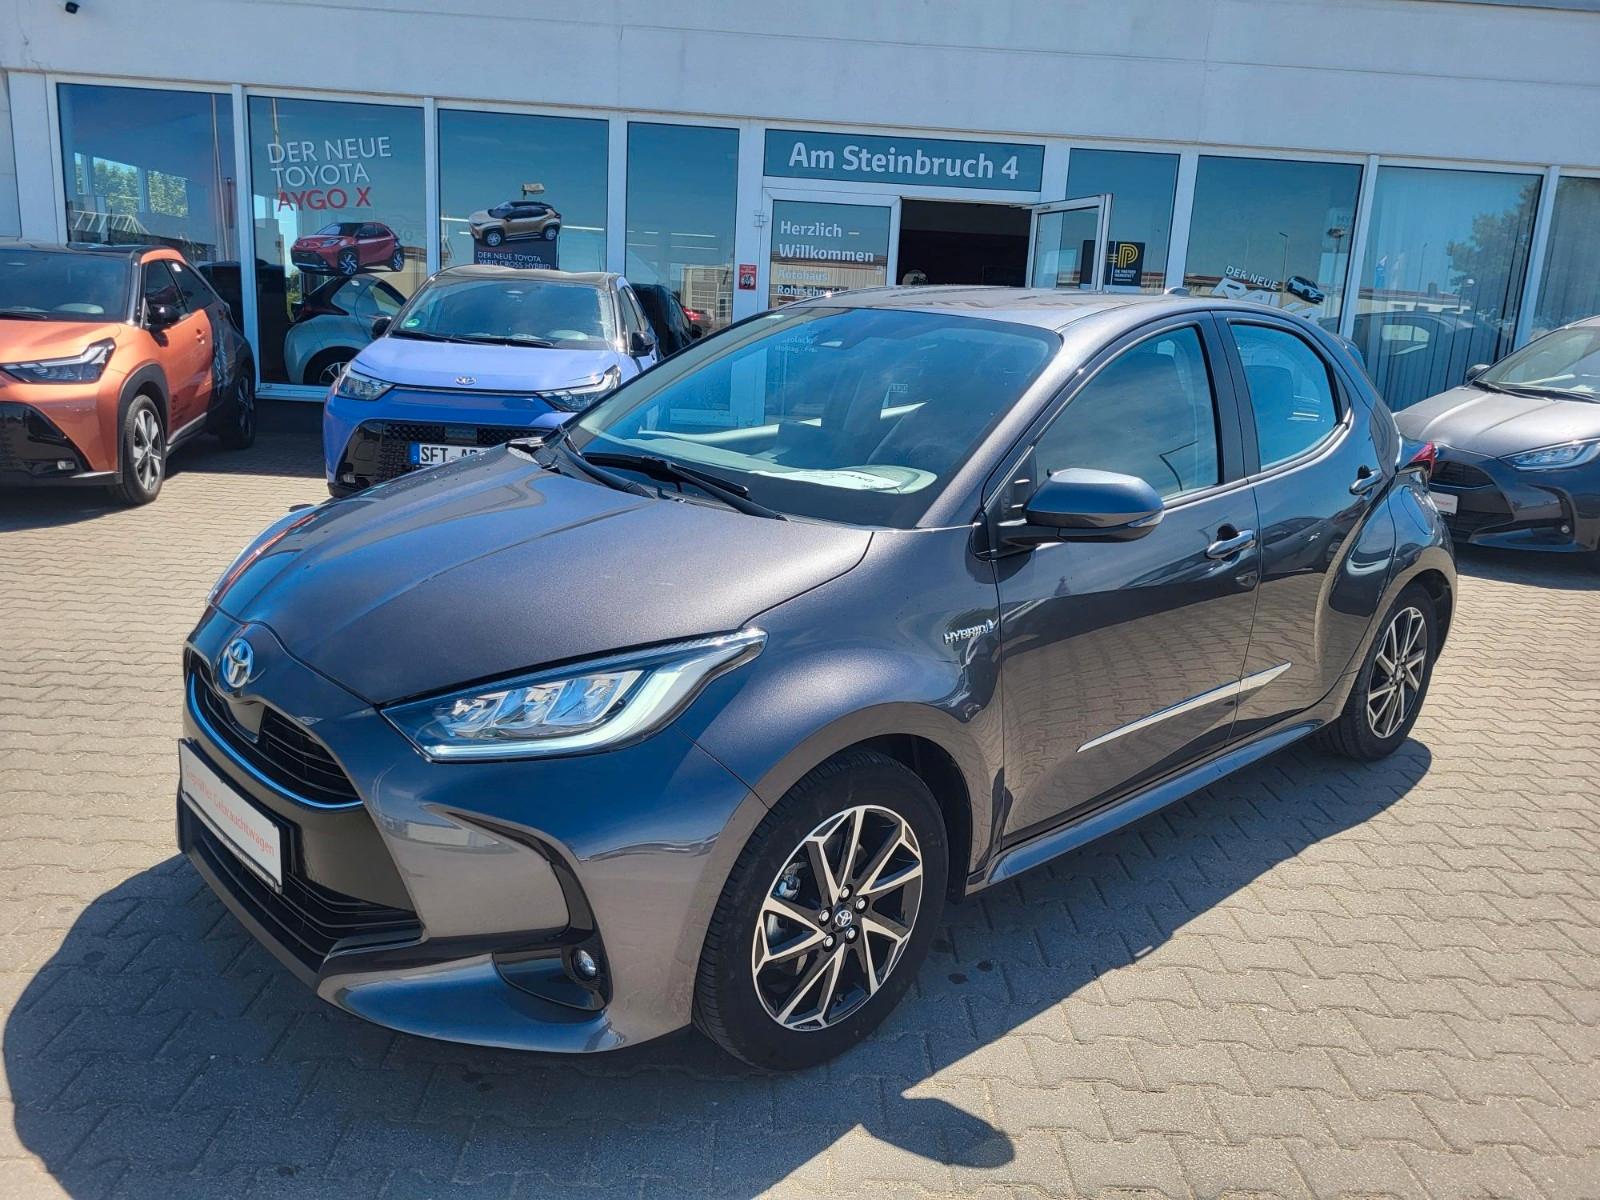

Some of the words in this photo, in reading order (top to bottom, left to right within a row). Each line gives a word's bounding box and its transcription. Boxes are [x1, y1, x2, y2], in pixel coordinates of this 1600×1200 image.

[267, 141, 318, 164] DER
[325, 137, 392, 161] NEUE
[788, 142, 835, 169] Am
[842, 145, 993, 178] Steinbruch
[1001, 155, 1019, 180] 4
[271, 162, 370, 187] TOYOTA
[278, 188, 348, 212] AYGO
[355, 186, 371, 207] X
[780, 220, 842, 238] Herzlich
[477, 251, 492, 259] DER
[493, 252, 513, 261] NEUE
[514, 254, 541, 263] TOYOTA
[779, 244, 874, 263] Willkommen
[1225, 265, 1247, 280] DER
[1250, 273, 1279, 291] NEUE
[421, 446, 449, 462] SFT
